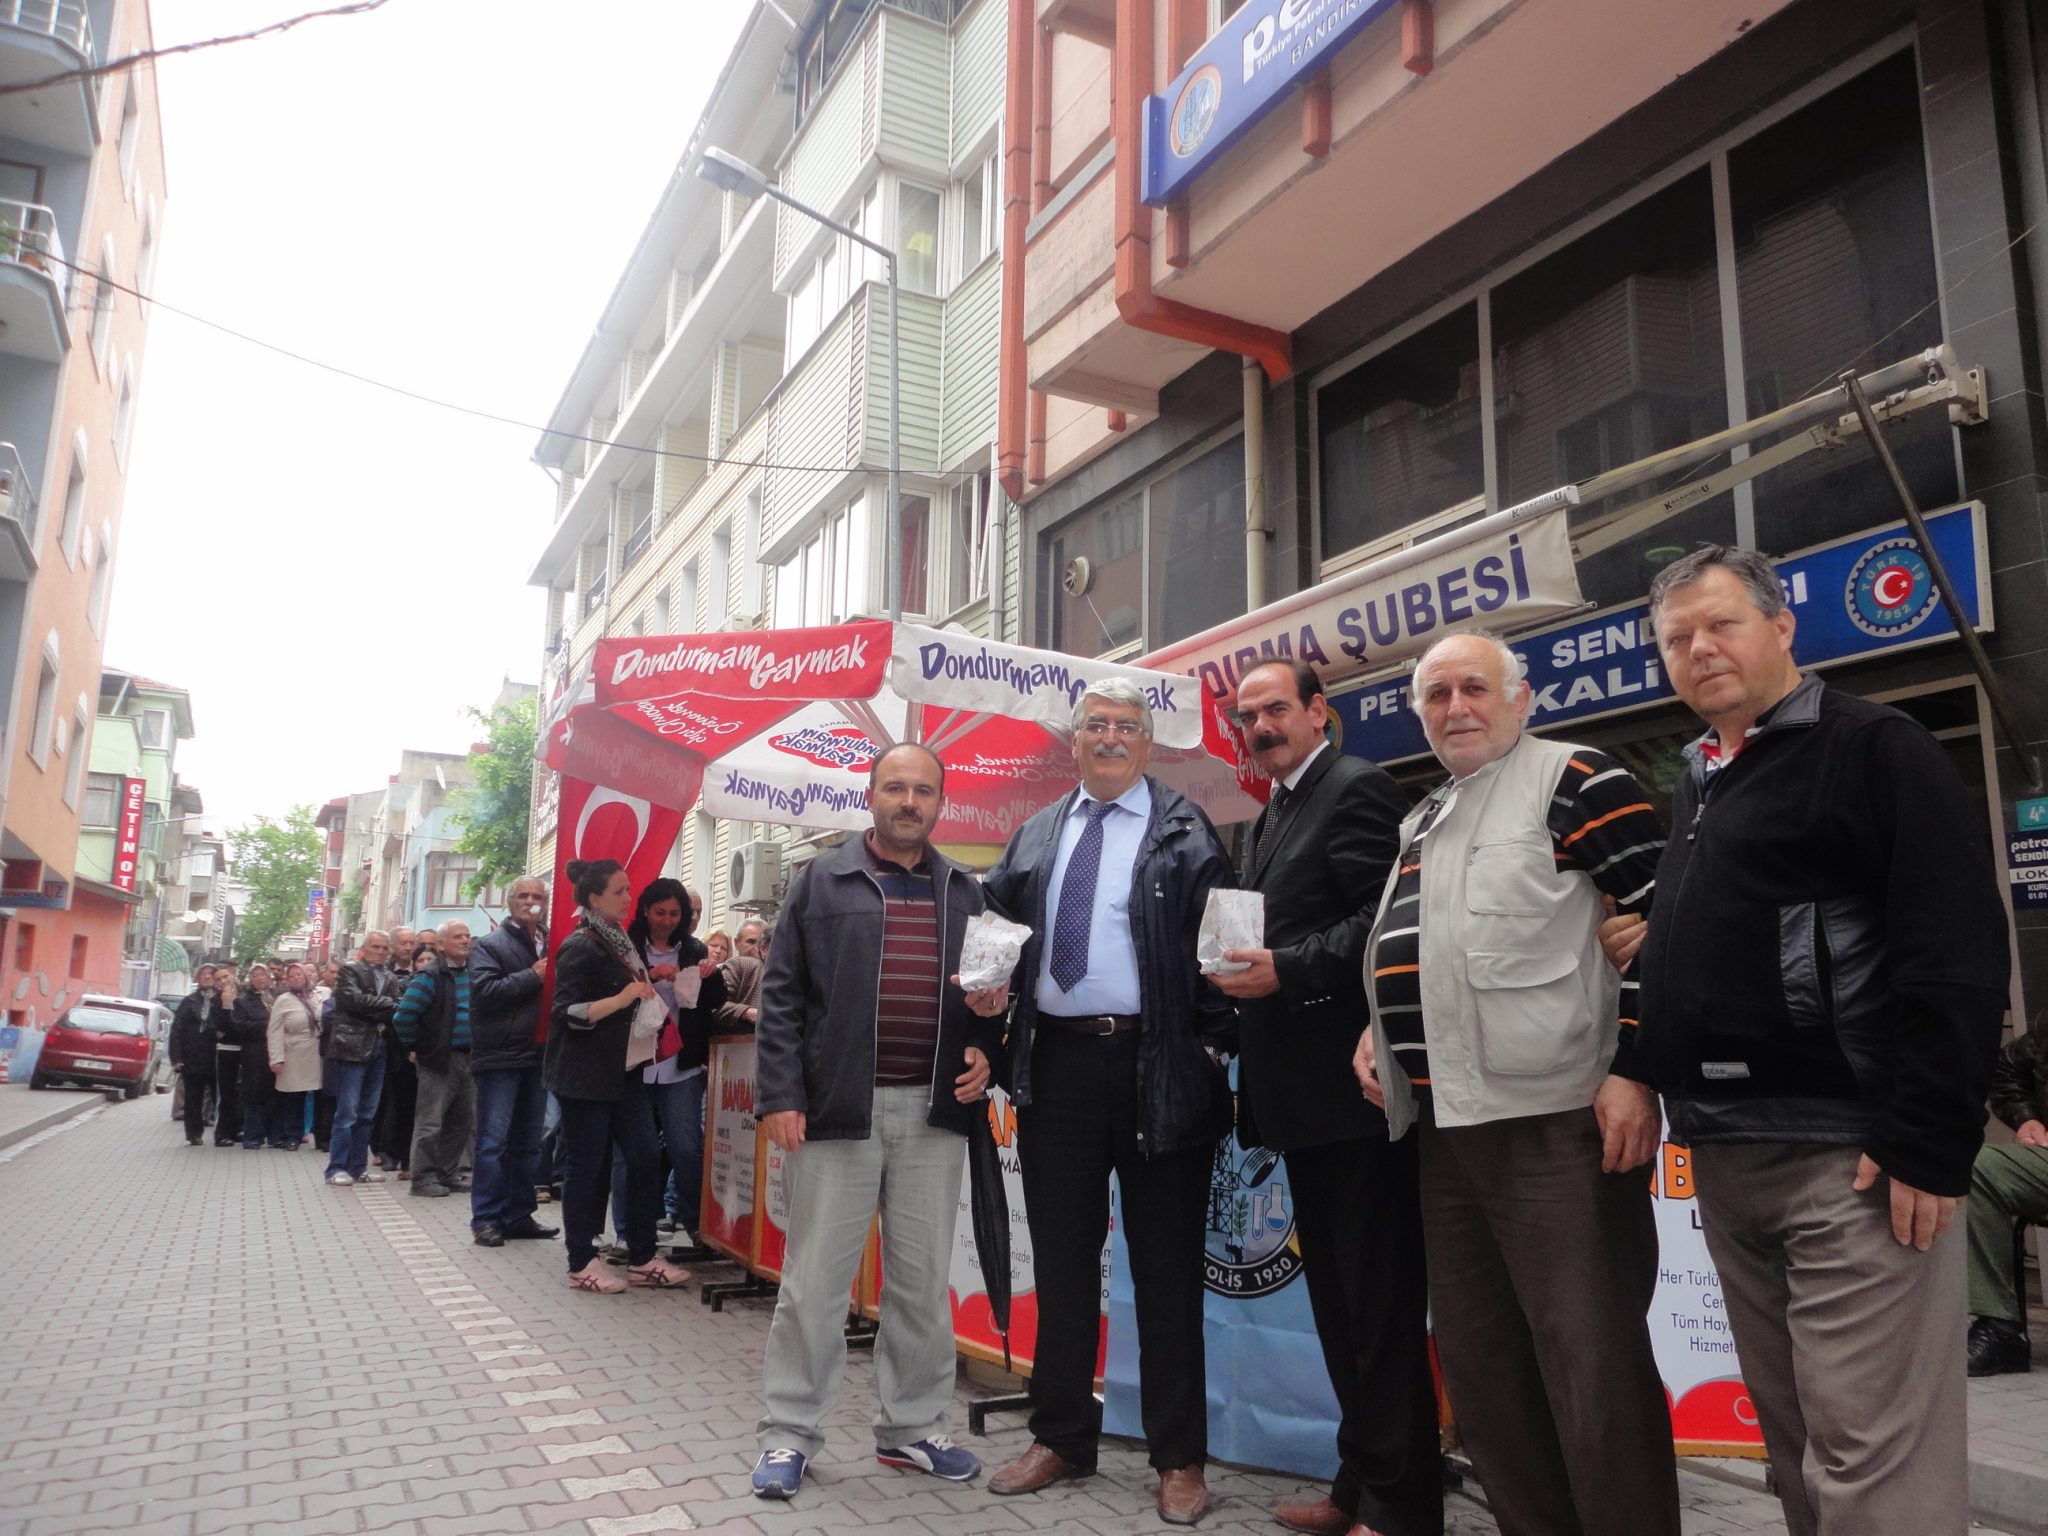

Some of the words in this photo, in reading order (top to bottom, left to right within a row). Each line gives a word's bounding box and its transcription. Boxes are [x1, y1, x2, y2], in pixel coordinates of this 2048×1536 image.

[1337, 533, 1531, 664] ŞUBESİ
[1876, 605, 1913, 620] 1952
[122, 783, 143, 853] ÇETİN
[1253, 1256, 1293, 1287] 1950
[1660, 1268, 1683, 1284] Her
[1687, 1270, 1719, 1287] Türlü
[1671, 1313, 1699, 1329] Tüm
